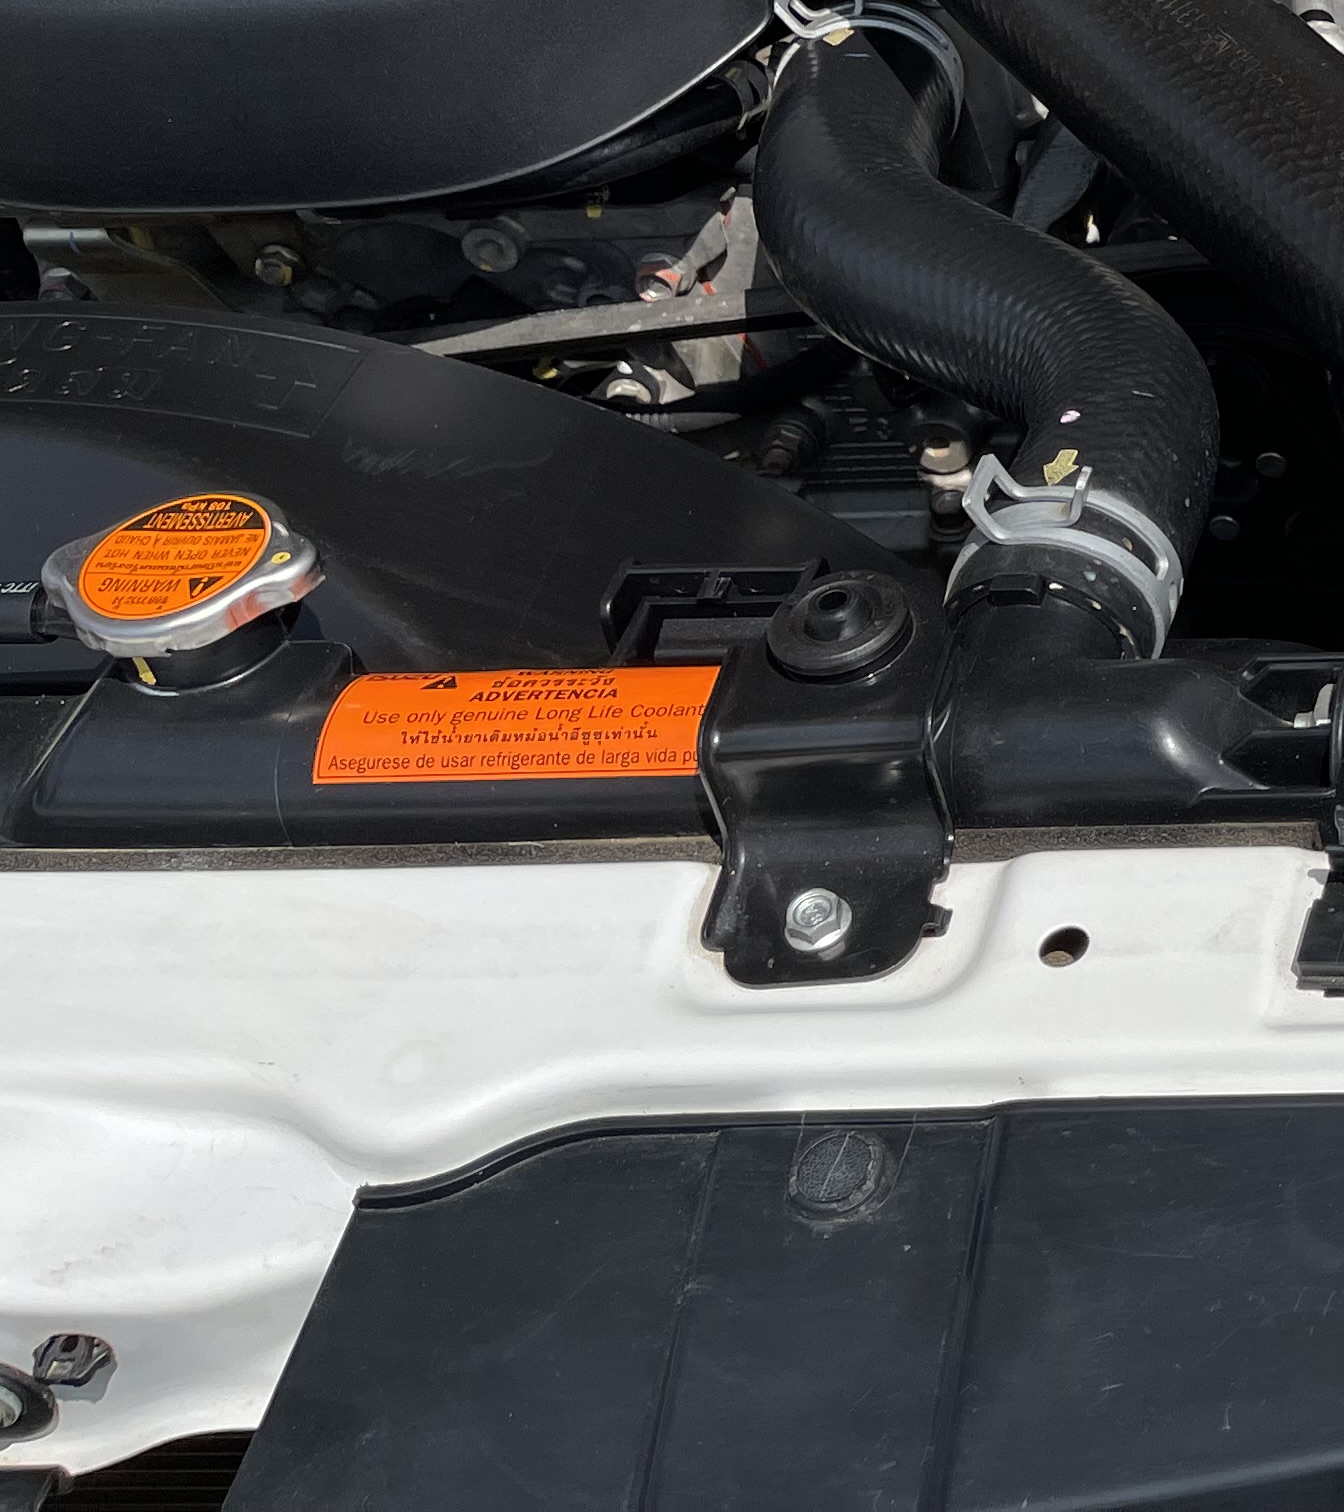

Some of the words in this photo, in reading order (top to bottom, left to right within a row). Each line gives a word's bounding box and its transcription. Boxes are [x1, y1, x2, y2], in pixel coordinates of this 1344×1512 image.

[142, 510, 254, 530] AVERTISSEMENT
[201, 533, 241, 546] JAMAIS
[132, 549, 171, 561] WHEN
[173, 549, 208, 560] OPEN
[211, 547, 252, 558] NEVER
[97, 577, 182, 593] WARNING
[468, 688, 618, 703] ADVERTENCIA
[363, 710, 401, 724] Use
[406, 708, 448, 727] only
[449, 706, 529, 726] genuine
[535, 706, 583, 723] Long
[587, 704, 624, 719] Life
[630, 702, 706, 719] Coolant
[328, 754, 411, 775] Asegurese
[415, 753, 435, 769] de
[441, 754, 476, 769] usar
[480, 748, 571, 771] refrigerante
[575, 750, 596, 765] de
[600, 748, 640, 768] larga
[645, 746, 677, 764] vida
